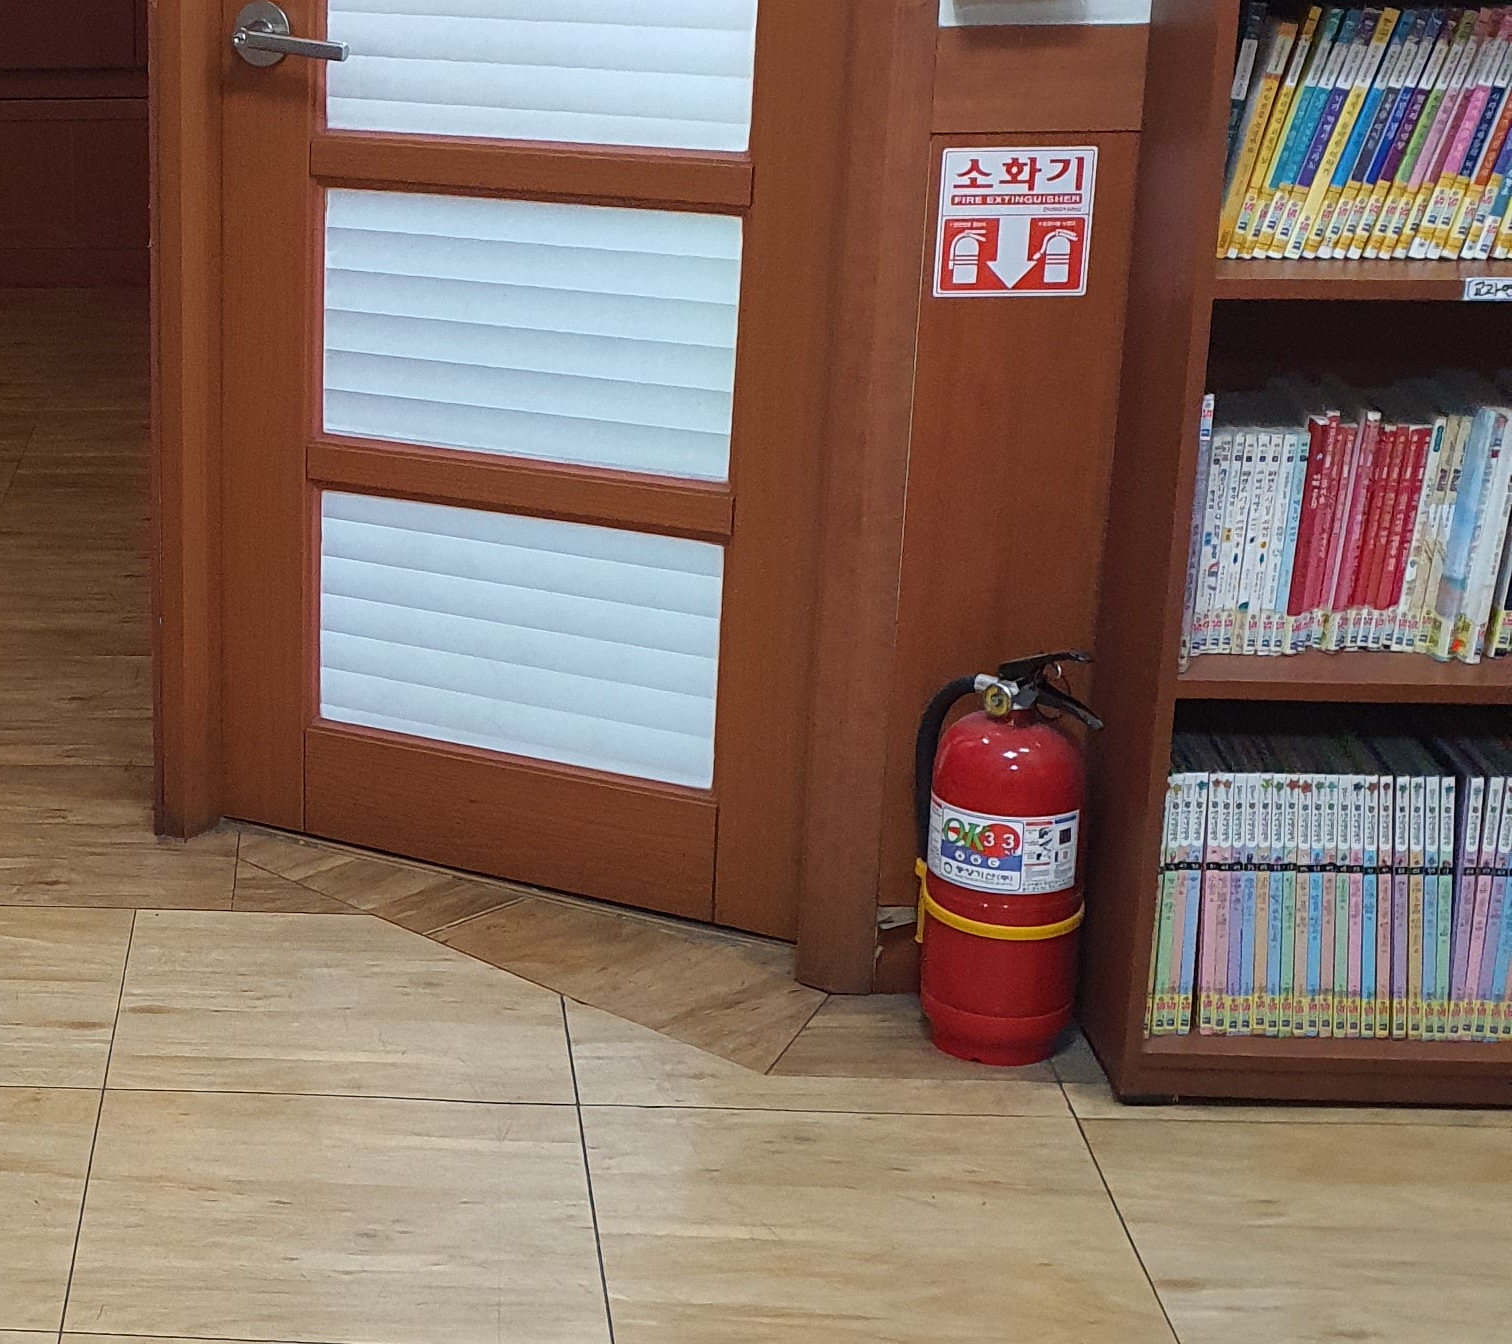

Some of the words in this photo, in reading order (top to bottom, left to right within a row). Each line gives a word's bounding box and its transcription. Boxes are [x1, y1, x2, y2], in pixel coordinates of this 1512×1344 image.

[953, 156, 1085, 192] 소화기
[953, 194, 983, 205] FIRE
[986, 194, 1081, 204] EXTINGUISHER
[942, 817, 991, 853] OK
